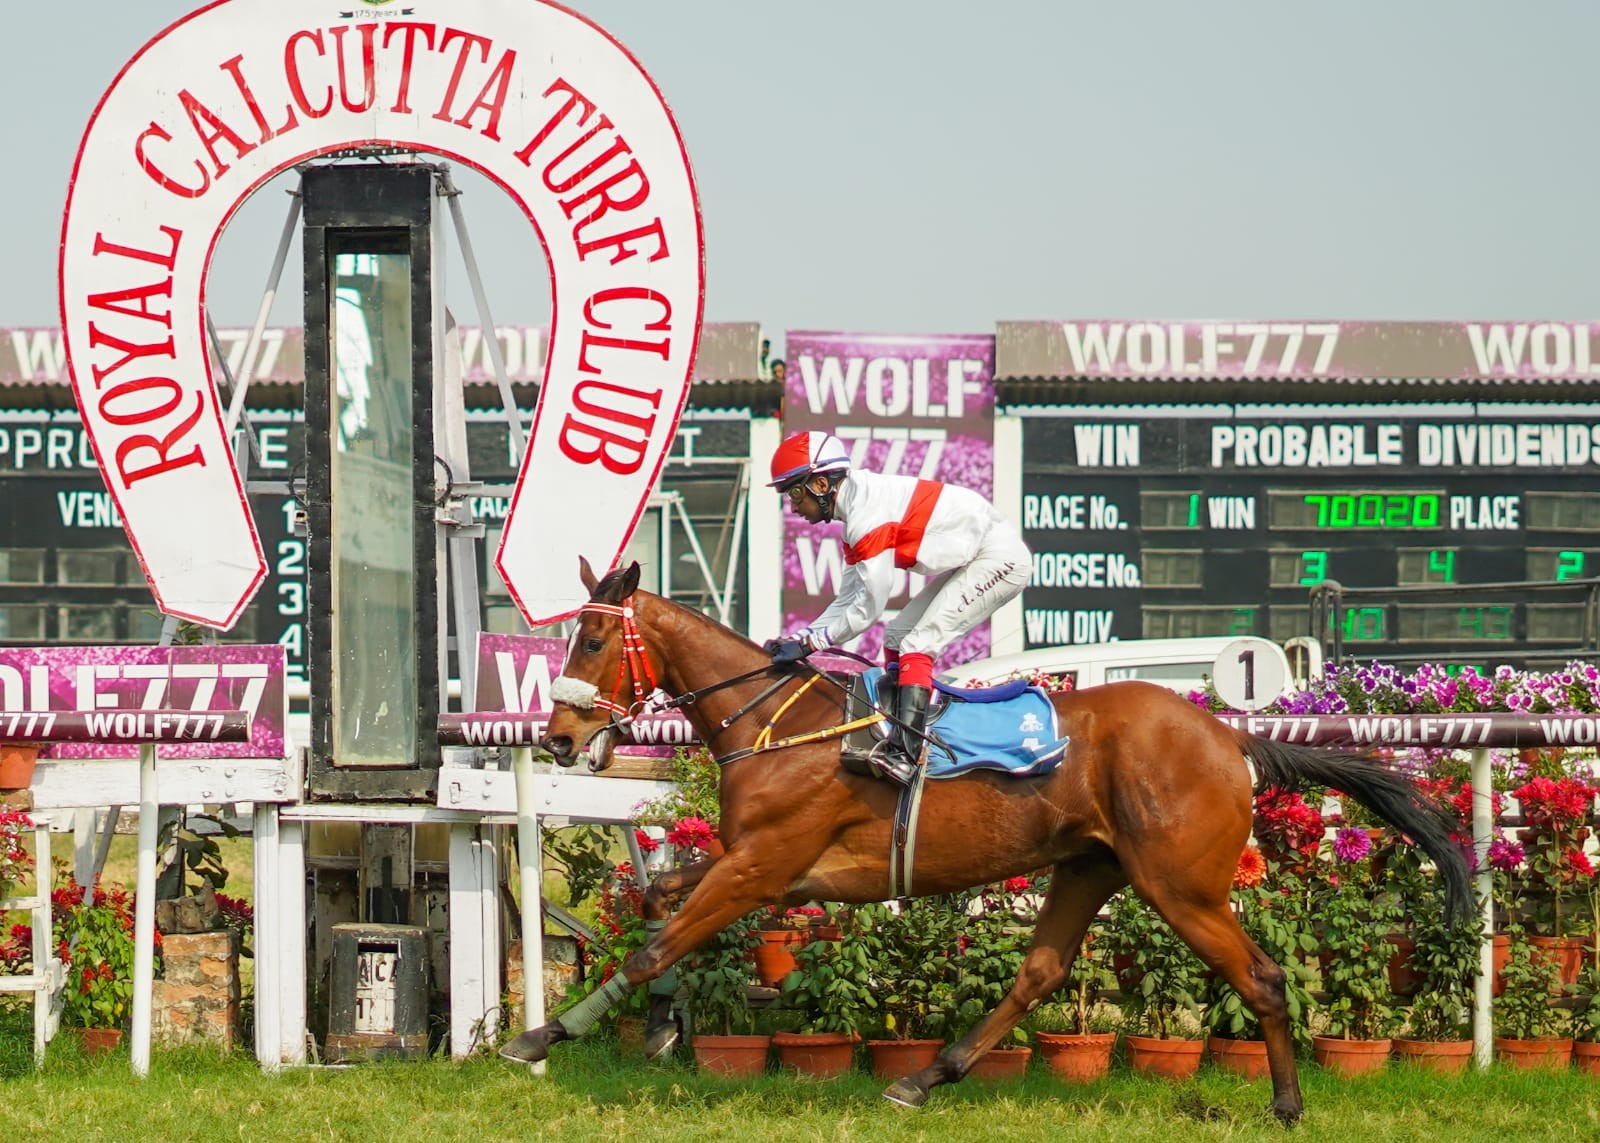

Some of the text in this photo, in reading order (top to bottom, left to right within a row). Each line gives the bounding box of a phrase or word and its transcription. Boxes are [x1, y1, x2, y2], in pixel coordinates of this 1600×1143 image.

[88, 22, 671, 489] ROYAL CALCUTTA TURF CLUB
[1063, 324, 1339, 374] WOLF777
[799, 355, 985, 418] WOLF
[1073, 424, 1140, 467] WIN
[1211, 424, 1403, 467] PROBABLE
[1023, 494, 1129, 530] RACE No.
[1207, 497, 1256, 529] WIN
[1449, 496, 1521, 530] PLACE
[277, 541, 304, 575] 2
[1028, 553, 1142, 588] HORSE No.
[1299, 551, 1328, 587] 3
[1429, 550, 1455, 583] 4
[1556, 550, 1585, 583] 2
[278, 583, 303, 615] 3
[279, 623, 302, 657] 4
[1025, 609, 1120, 645] WIN DIV.
[1238, 650, 1255, 700] 1
[85, 713, 225, 739] WOLF777
[1347, 717, 1493, 743] WOLF777
